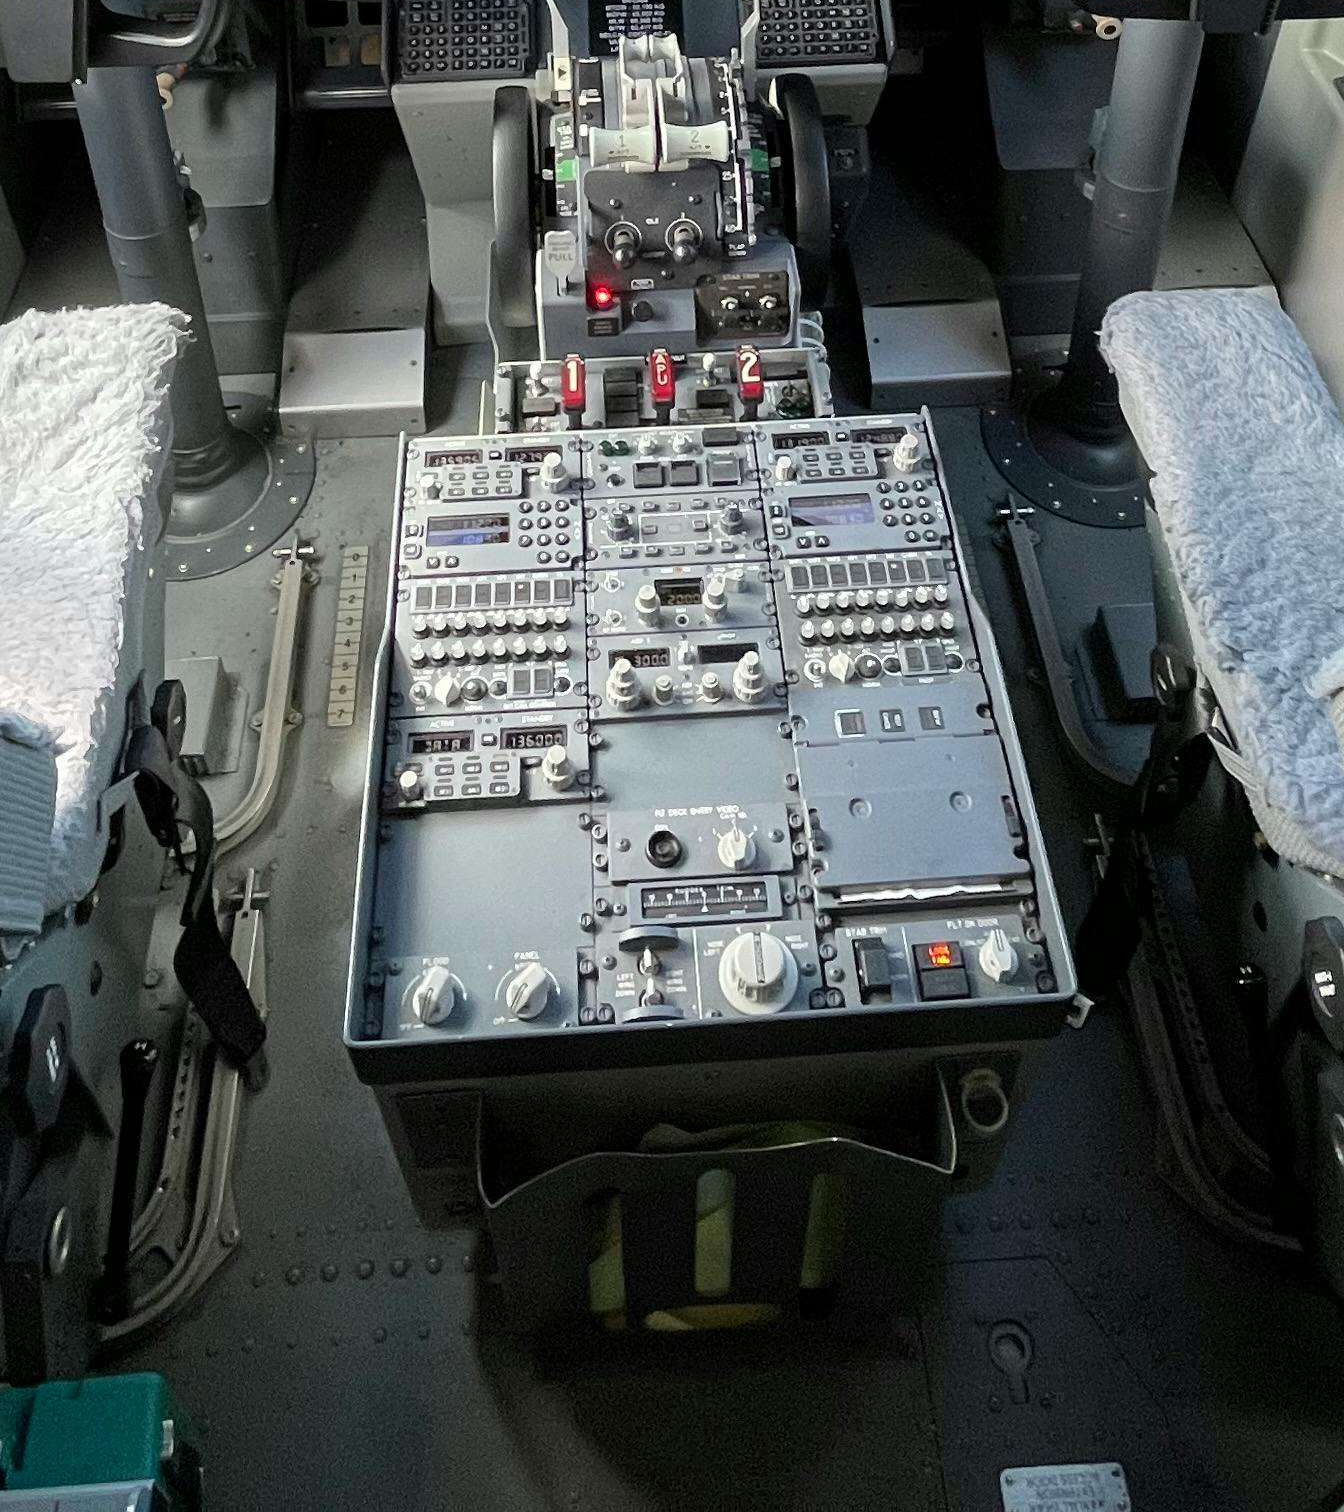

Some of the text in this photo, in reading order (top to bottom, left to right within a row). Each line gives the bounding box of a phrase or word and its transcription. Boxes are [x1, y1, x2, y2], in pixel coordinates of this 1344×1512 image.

[690, 129, 699, 139] 2
[567, 361, 578, 392] 1
[654, 355, 668, 385] APU
[741, 351, 761, 383] 2
[429, 719, 455, 728] ACTIVE
